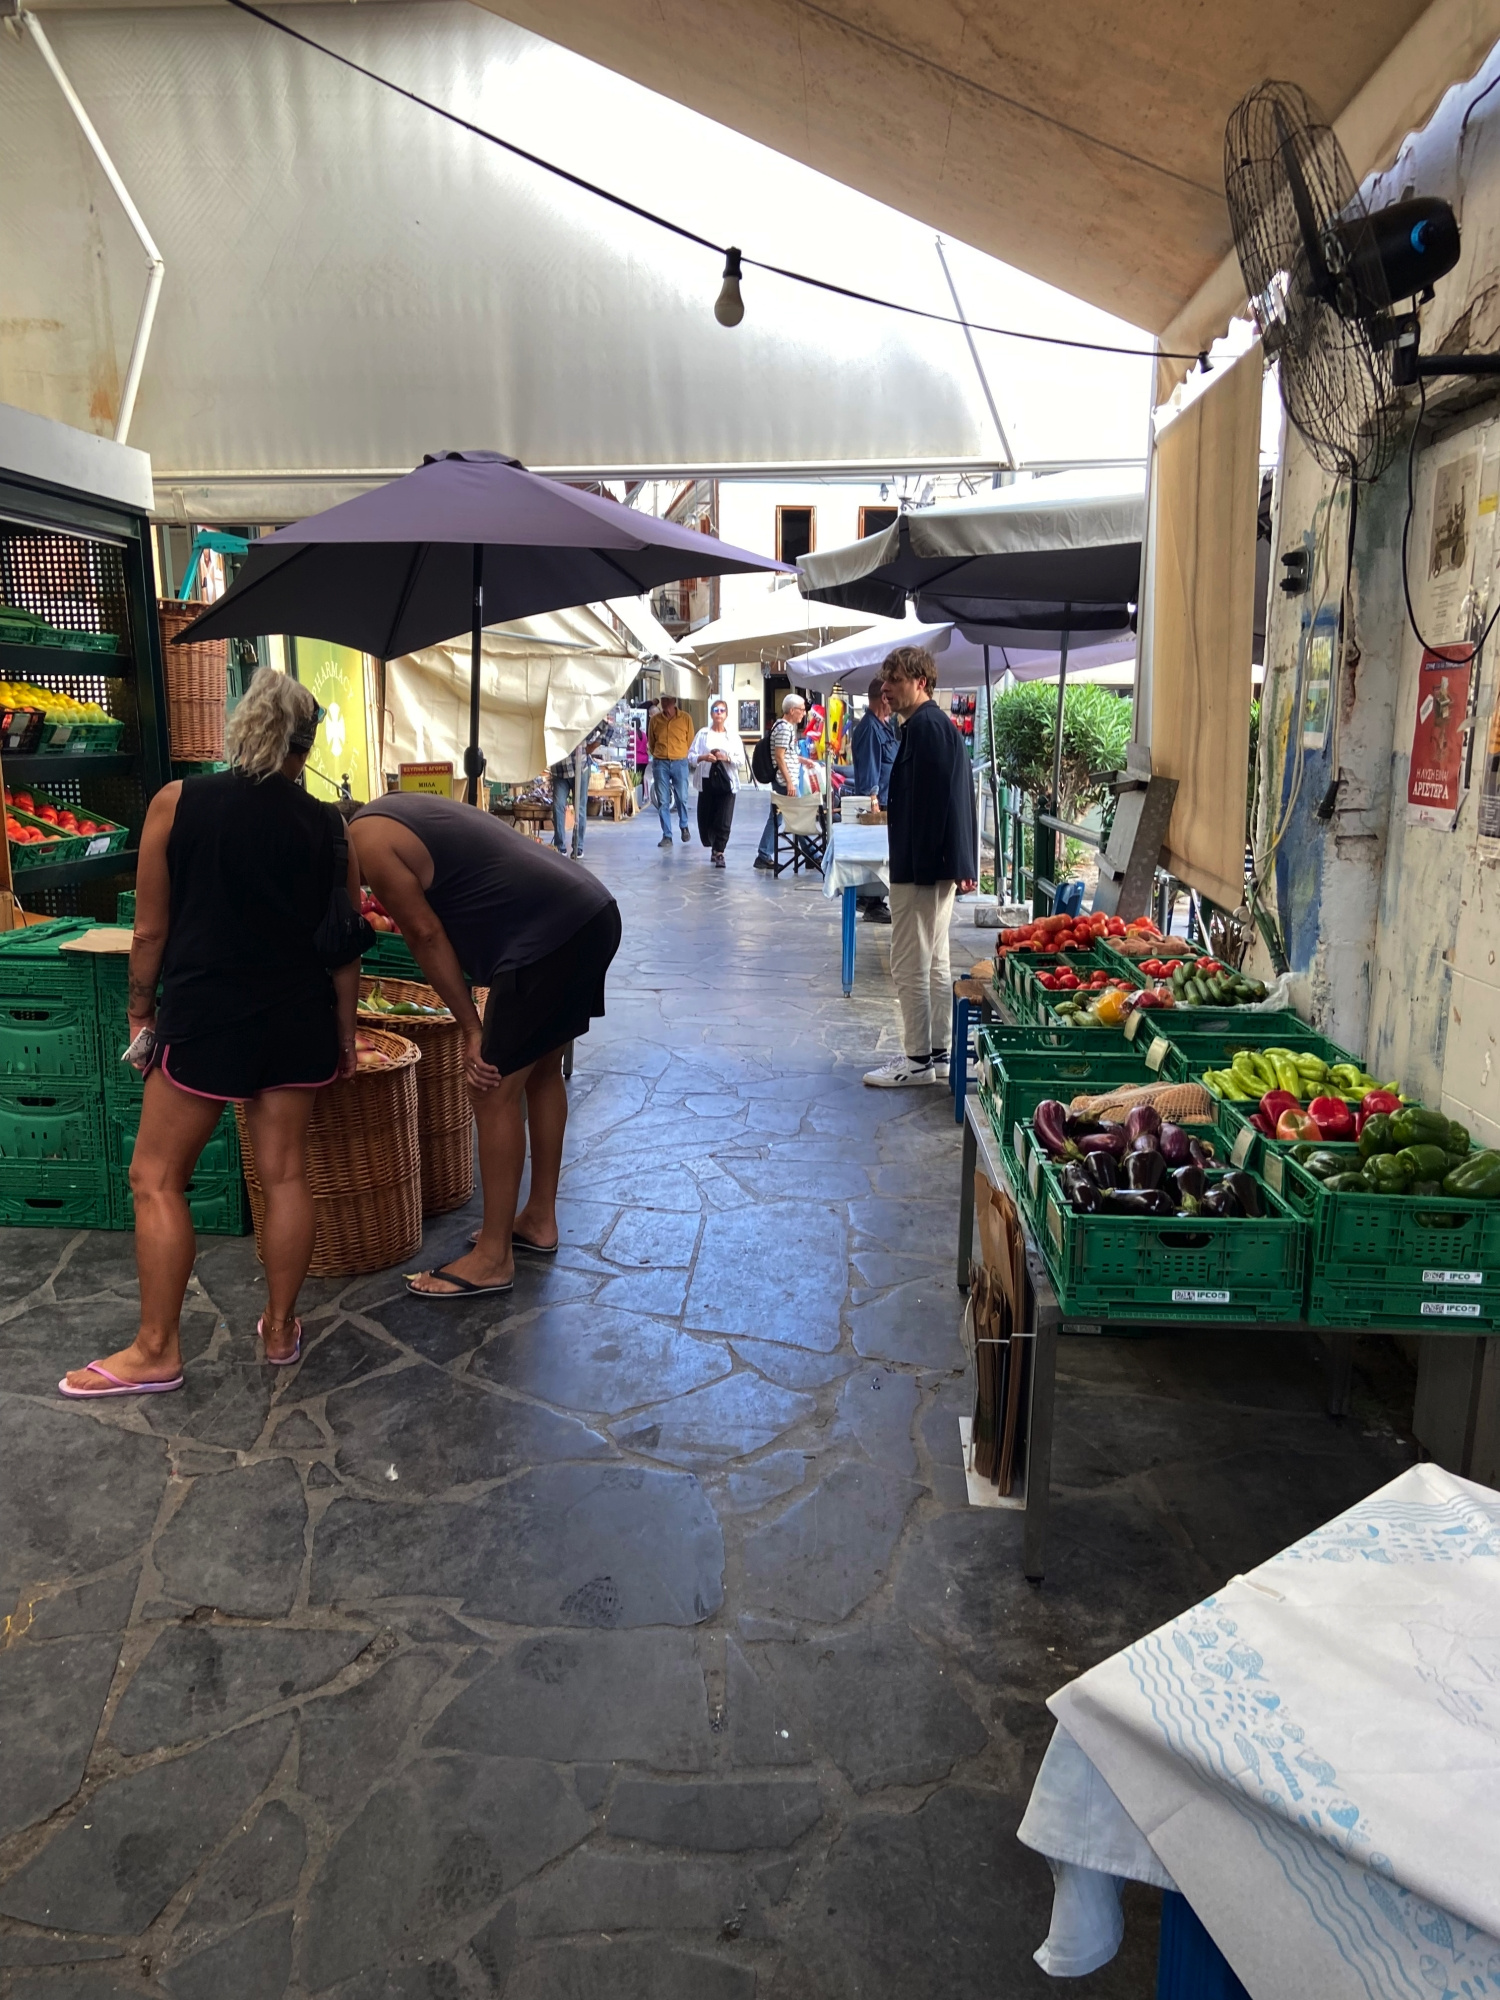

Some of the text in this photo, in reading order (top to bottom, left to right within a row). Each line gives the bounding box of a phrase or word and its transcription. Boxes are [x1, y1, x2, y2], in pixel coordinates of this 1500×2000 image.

[312, 660, 353, 701] PHARMACY
[1412, 781, 1449, 800] ΑΡΙΣΤΕΡΑ
[1197, 1291, 1217, 1299] IFCO
[1446, 1304, 1468, 1312] IFCO
